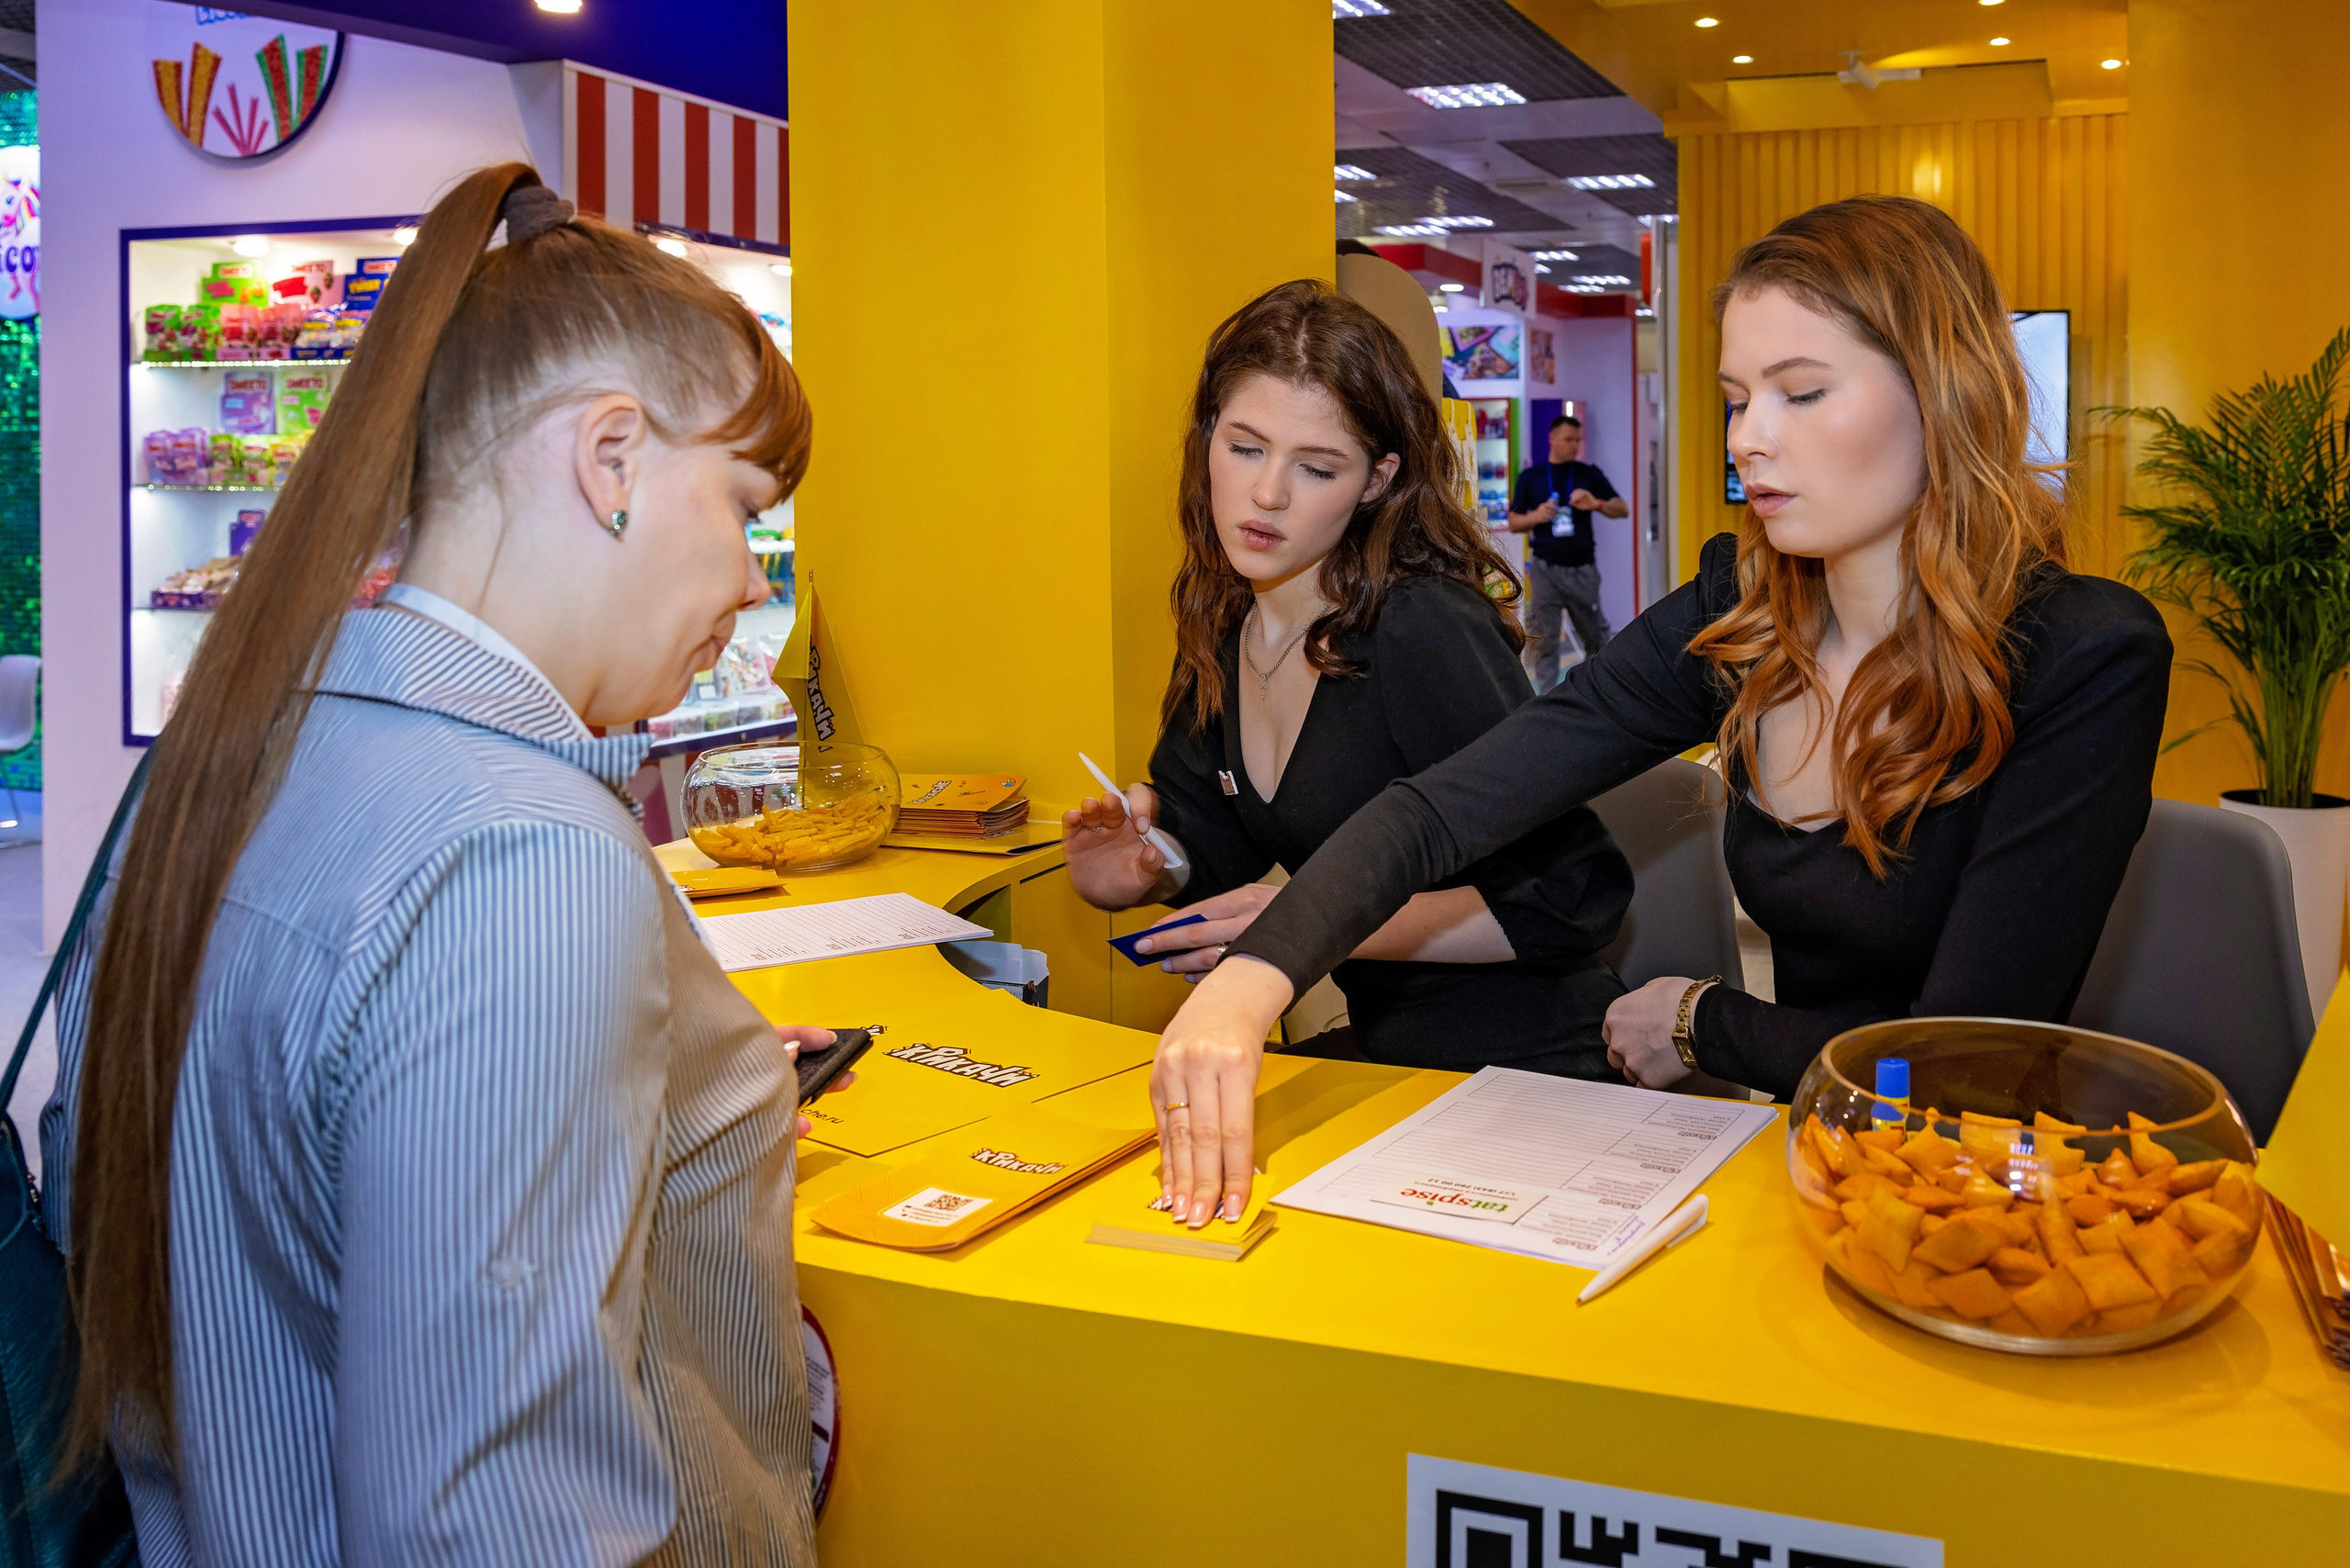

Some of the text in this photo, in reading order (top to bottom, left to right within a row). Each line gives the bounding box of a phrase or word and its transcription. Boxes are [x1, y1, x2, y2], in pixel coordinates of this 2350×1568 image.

[808, 643, 836, 741] РИКАЧИ
[800, 1109, 845, 1124] che.ru
[1400, 1187, 1509, 1213] tatspise
